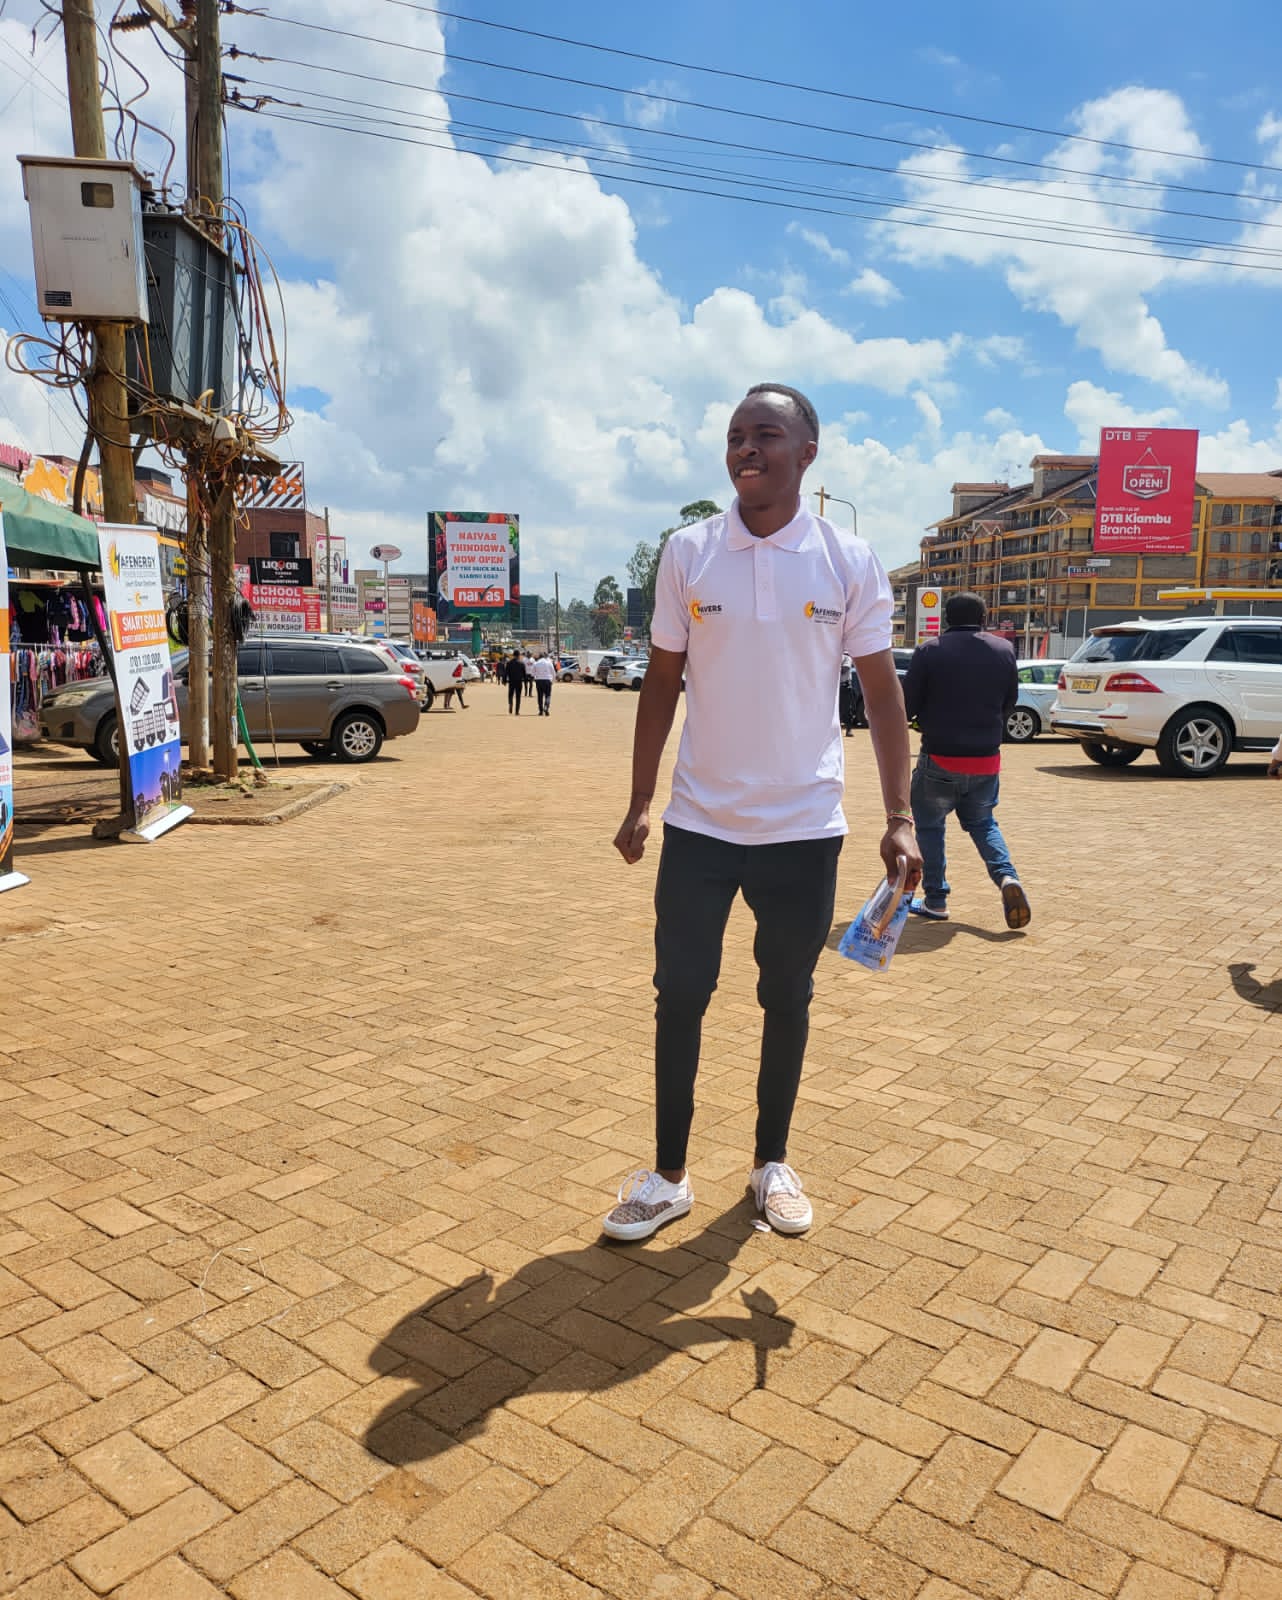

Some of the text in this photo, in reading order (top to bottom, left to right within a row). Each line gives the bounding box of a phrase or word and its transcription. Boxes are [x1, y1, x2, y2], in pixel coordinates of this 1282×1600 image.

[1105, 430, 1131, 441] DTB
[1129, 479, 1163, 488] OPEN!
[1101, 512, 1171, 524] DTB Kiambu
[1100, 525, 1141, 535] Branch
[458, 532, 496, 540] NAIVAS
[450, 544, 506, 552] THINDIGWA
[454, 555, 504, 564] NOW OPEN
[252, 587, 301, 597] SCHOOL
[458, 584, 500, 602] naivas
[252, 597, 300, 606] UNIFORM
[281, 614, 302, 622] BAGS
